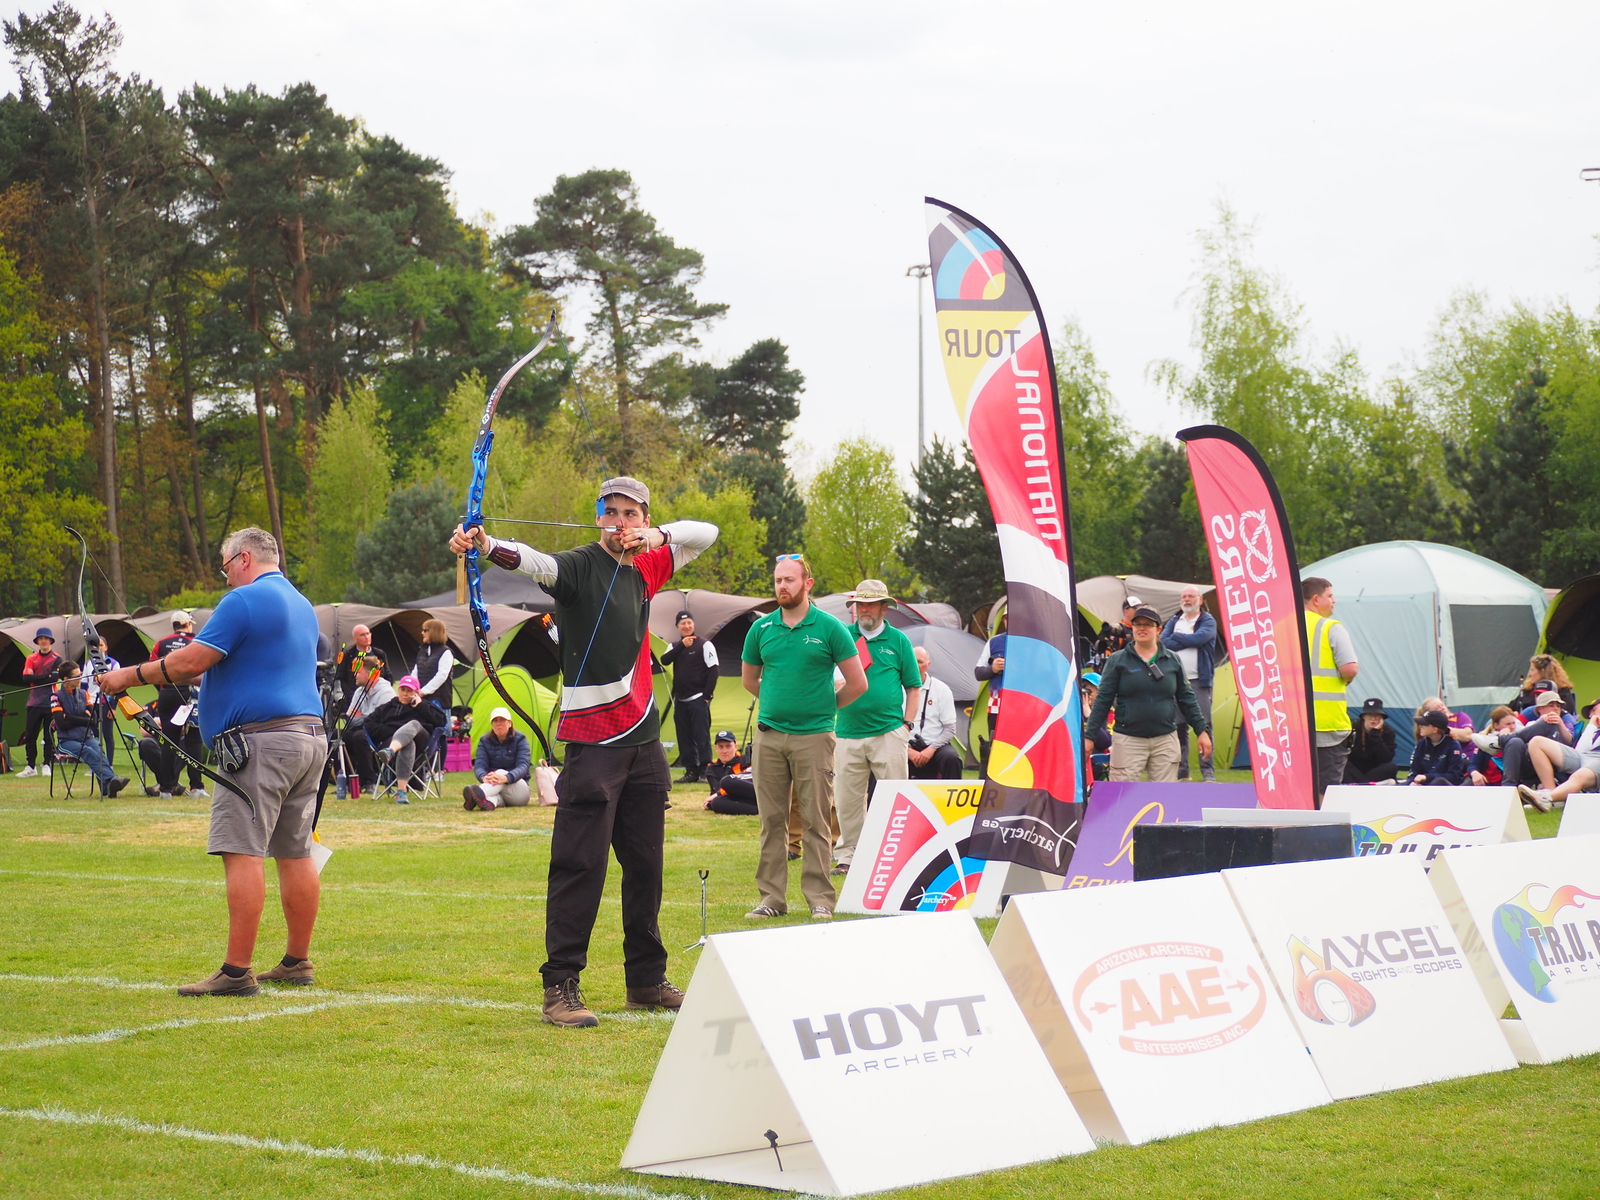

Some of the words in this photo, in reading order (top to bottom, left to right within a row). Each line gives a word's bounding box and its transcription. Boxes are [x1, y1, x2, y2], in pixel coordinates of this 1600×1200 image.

[946, 788, 999, 808] TOUR
[867, 804, 911, 900] NATIONAL
[923, 895, 950, 907] archery
[1095, 948, 1148, 975] ARIZONA
[1149, 944, 1211, 958] ARCHERY
[1321, 926, 1457, 972] AXCEL
[1351, 967, 1398, 983] SIGHTS
[1397, 966, 1414, 975] AND
[1413, 959, 1463, 974] SCOPES
[1120, 966, 1233, 1031] AAE
[792, 994, 987, 1060] HOYT
[1132, 1034, 1223, 1054] ENTERPRISES
[1222, 1024, 1248, 1042] INC.
[844, 1046, 974, 1075] ARCHERY
